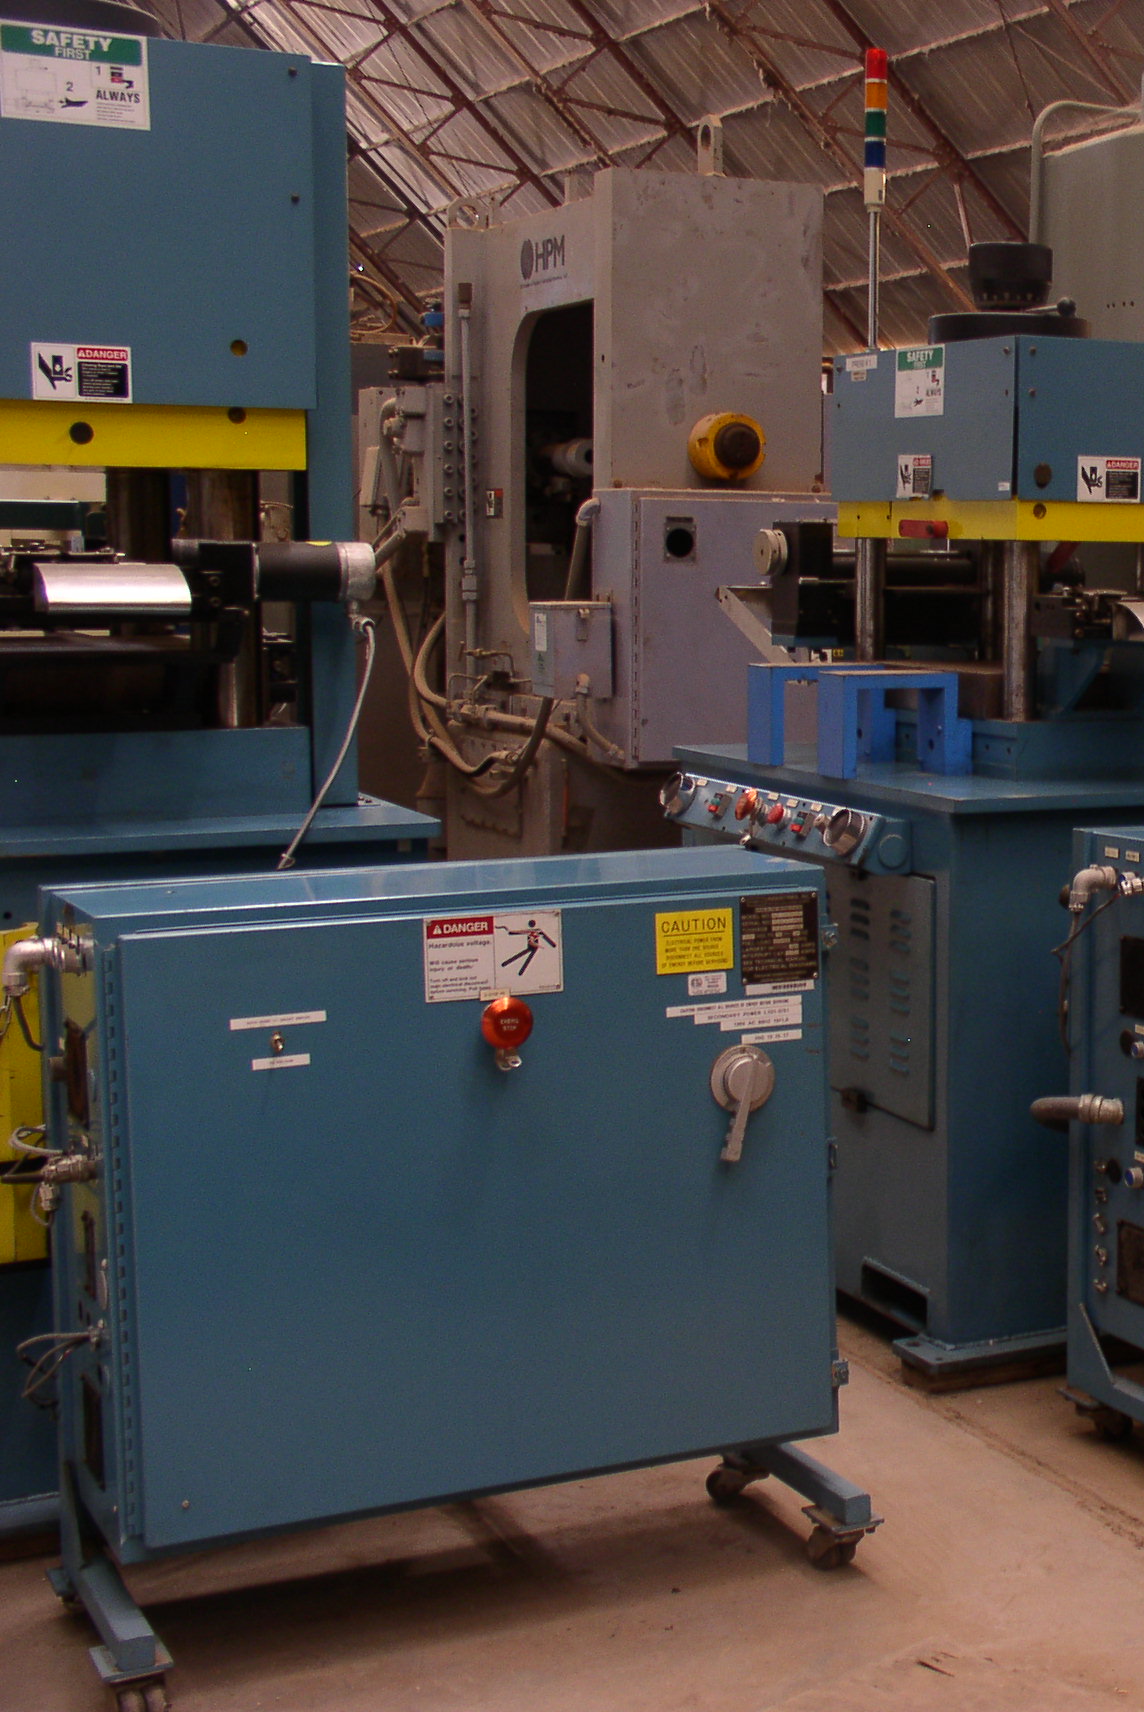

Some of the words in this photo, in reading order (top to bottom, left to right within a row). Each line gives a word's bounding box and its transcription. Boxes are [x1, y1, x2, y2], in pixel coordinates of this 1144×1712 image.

[31, 29, 113, 52] SAFETY
[54, 46, 92, 60] FIRST
[95, 66, 102, 76] 1
[65, 81, 74, 92] 2
[95, 89, 141, 104] ALWAYS
[535, 234, 566, 273] HPM
[86, 350, 127, 360] DANGER
[906, 350, 934, 362] SAFETY
[443, 921, 489, 934] DANGER
[661, 917, 727, 934] CAUTION
